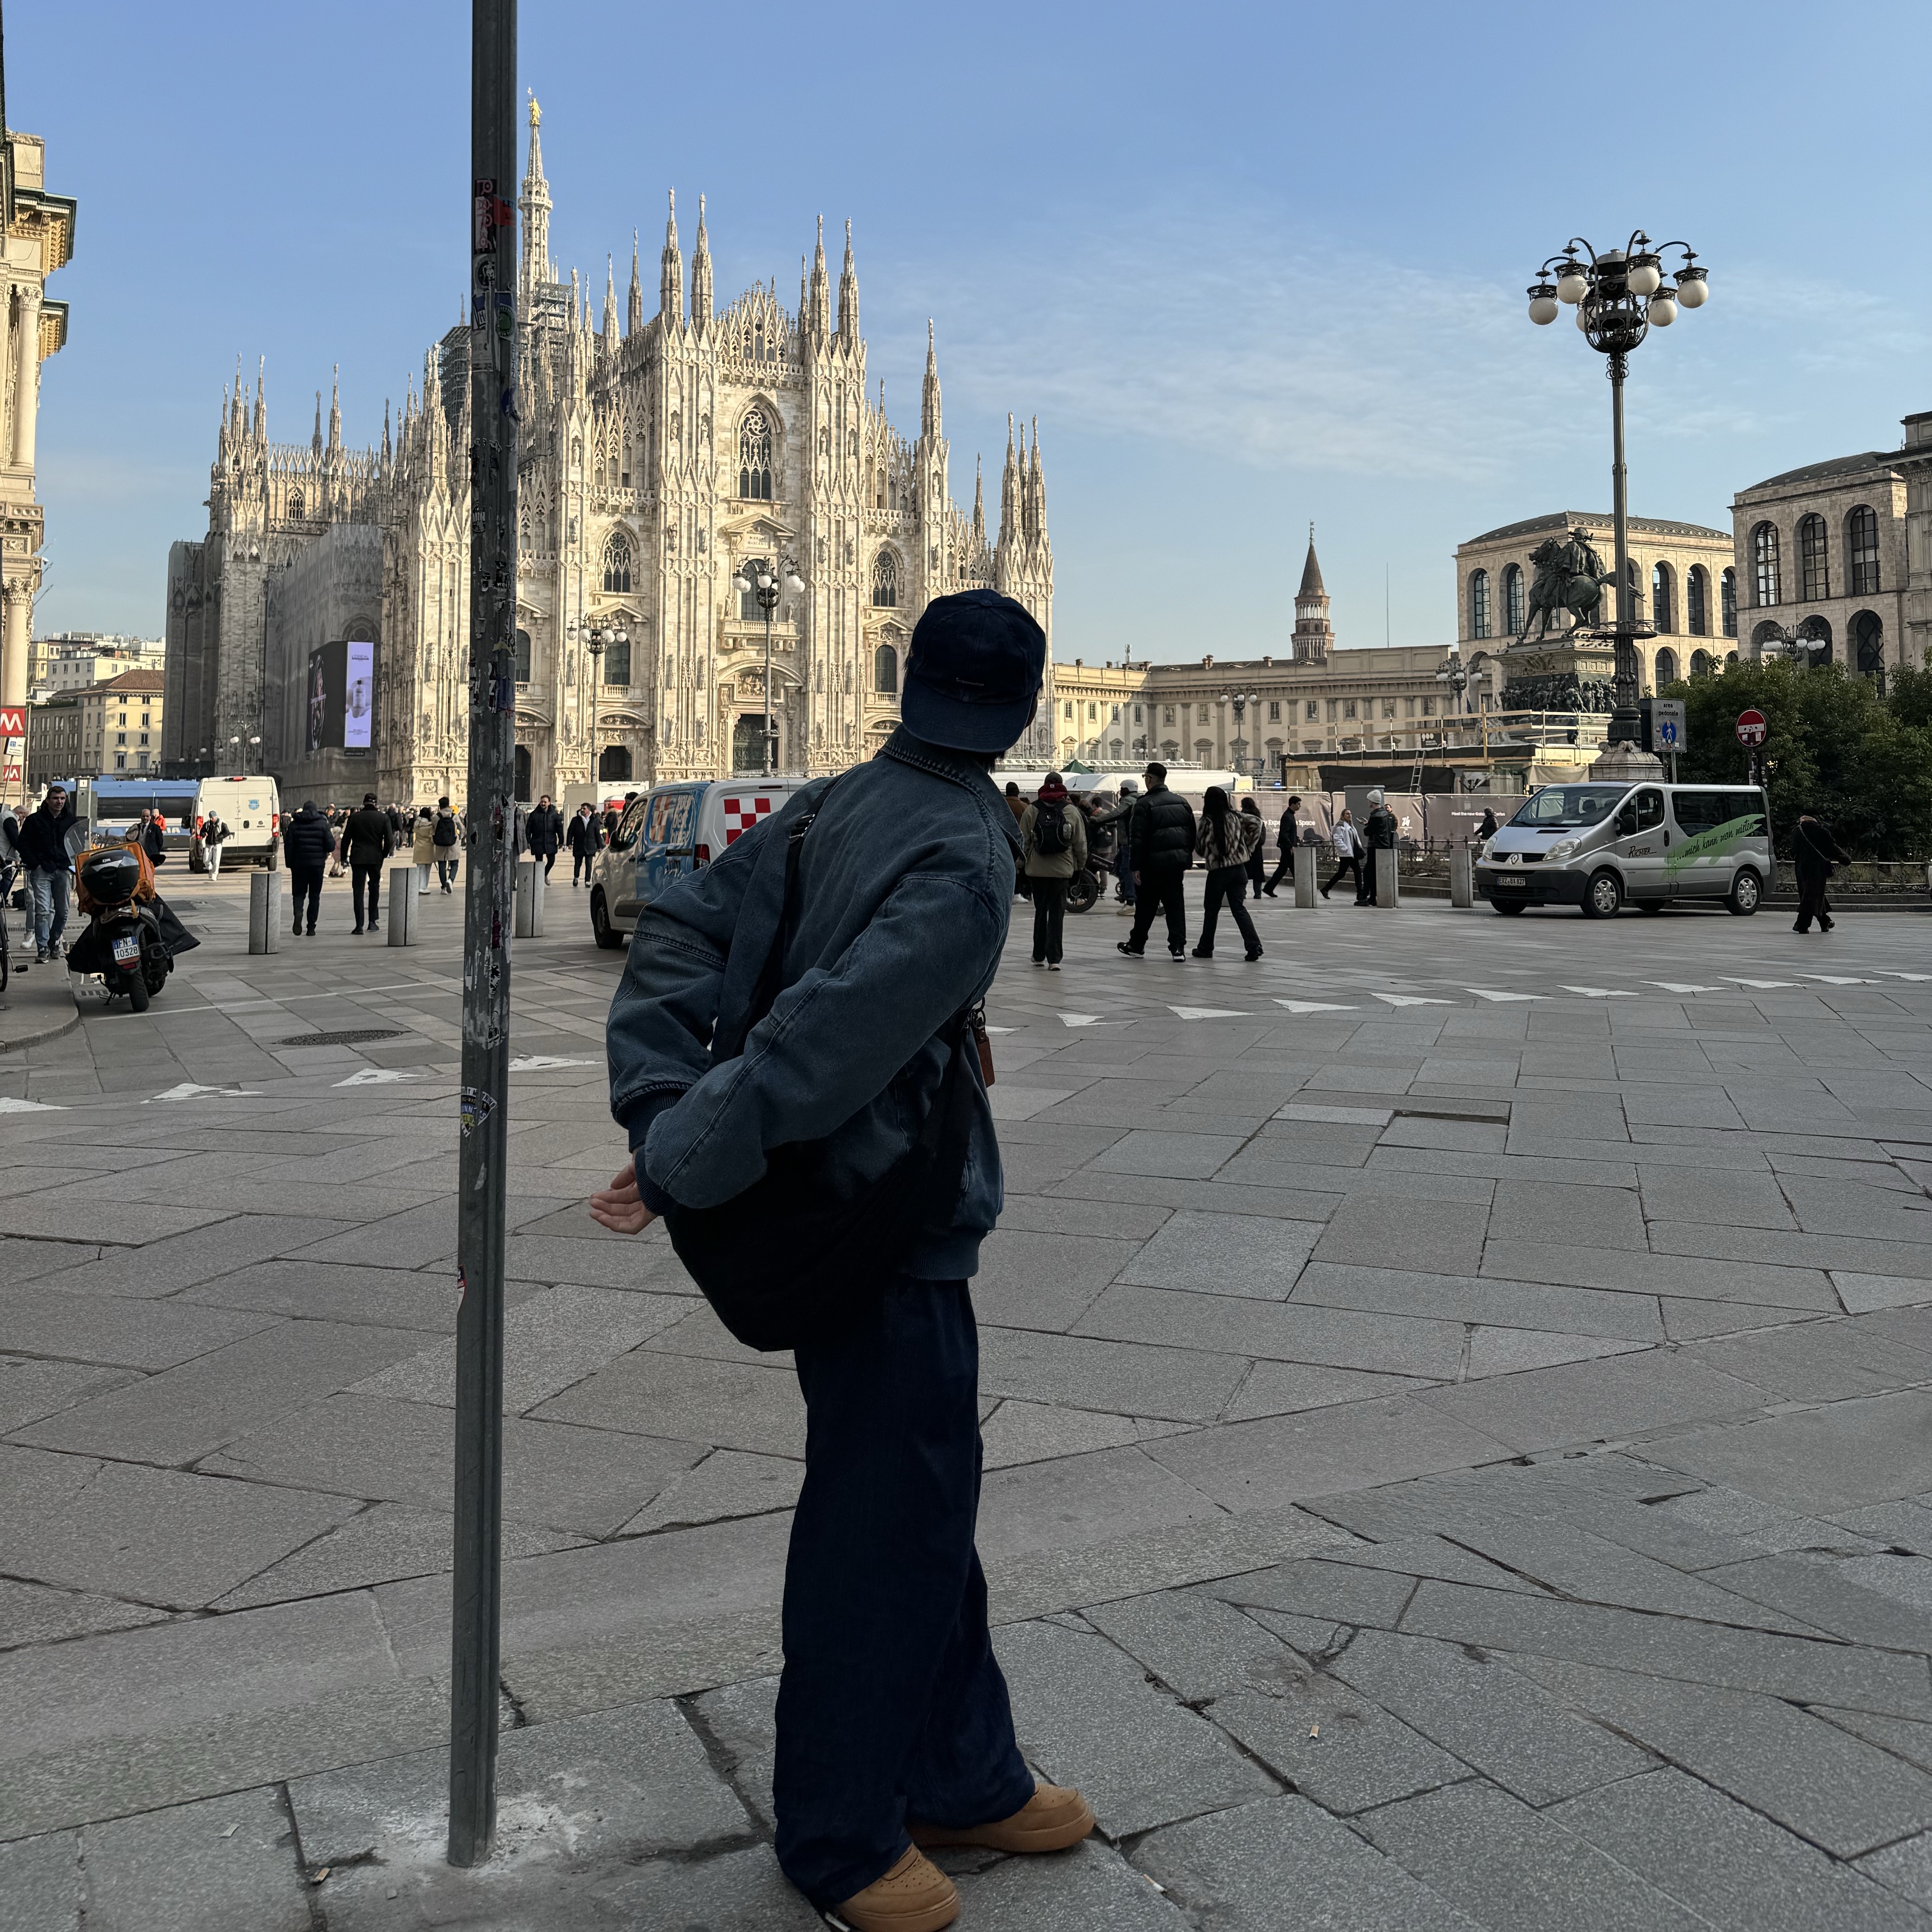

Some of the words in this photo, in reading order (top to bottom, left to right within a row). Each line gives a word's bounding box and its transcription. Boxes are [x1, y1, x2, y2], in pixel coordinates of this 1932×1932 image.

[0, 713, 23, 731] M
[1702, 837, 1718, 851] kann
[1720, 830, 1734, 842] man
[1736, 819, 1754, 836] mieten
[118, 938, 128, 948] FN
[116, 946, 138, 958] 10328
